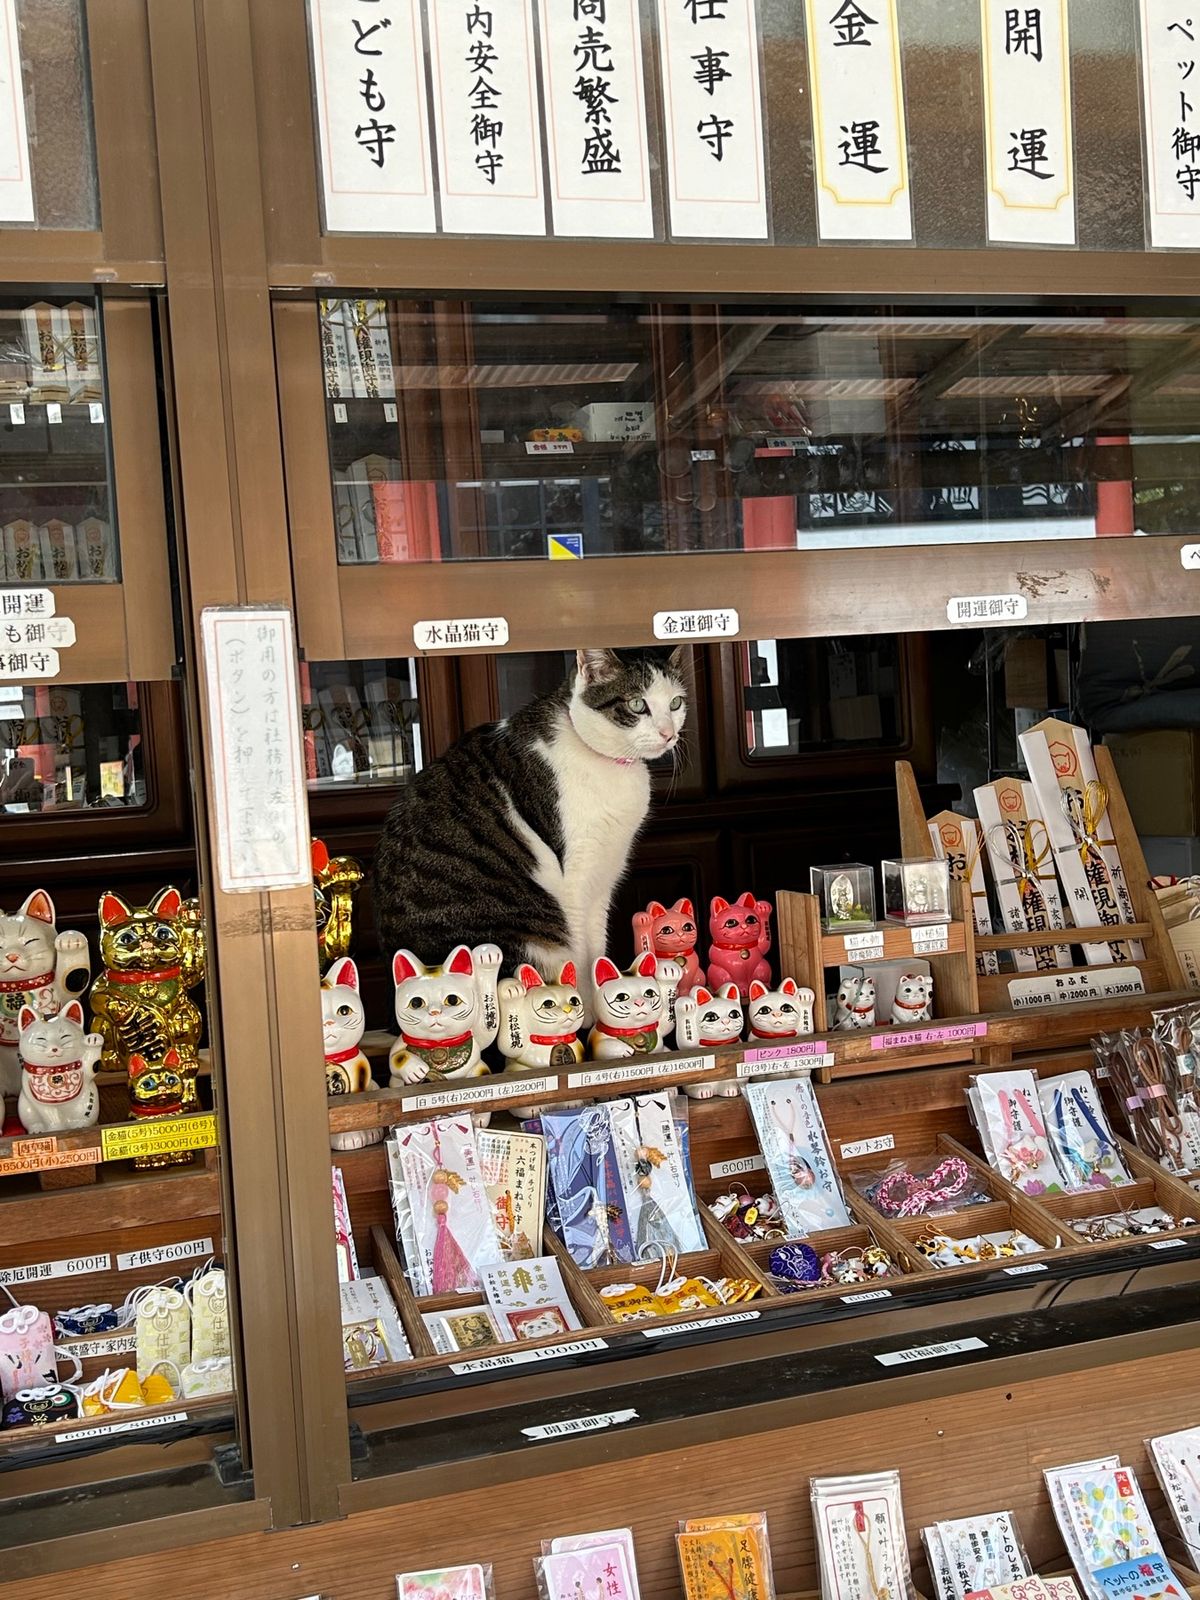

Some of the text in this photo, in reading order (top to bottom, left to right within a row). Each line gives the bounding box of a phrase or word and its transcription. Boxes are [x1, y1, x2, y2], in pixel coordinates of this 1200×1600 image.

[351, 0, 397, 168] ども守
[464, 0, 505, 185] 内安全御守
[829, 0, 889, 174] 金運
[1005, 8, 1055, 180] 開運
[1167, 18, 1200, 200] ペット御守
[957, 598, 1019, 619] 開運御守
[425, 621, 500, 644] 水晶猫守
[662, 613, 730, 635] 金運御守
[1055, 974, 1089, 988] おふだ
[483, 993, 497, 1029] お松権現
[508, 1014, 523, 1049] お松権現
[760, 1048, 782, 1058] ピンク
[843, 1136, 894, 1155] ペットお守
[721, 1159, 755, 1175] 600円
[514, 1155, 526, 1225] 六福まねき守
[67, 1256, 108, 1273] 600円
[126, 1240, 206, 1267] 子供守600円
[460, 1341, 599, 1373] 水晶猫 1000円
[1116, 1472, 1131, 1495] 光る
[603, 1562, 622, 1597] 女性
